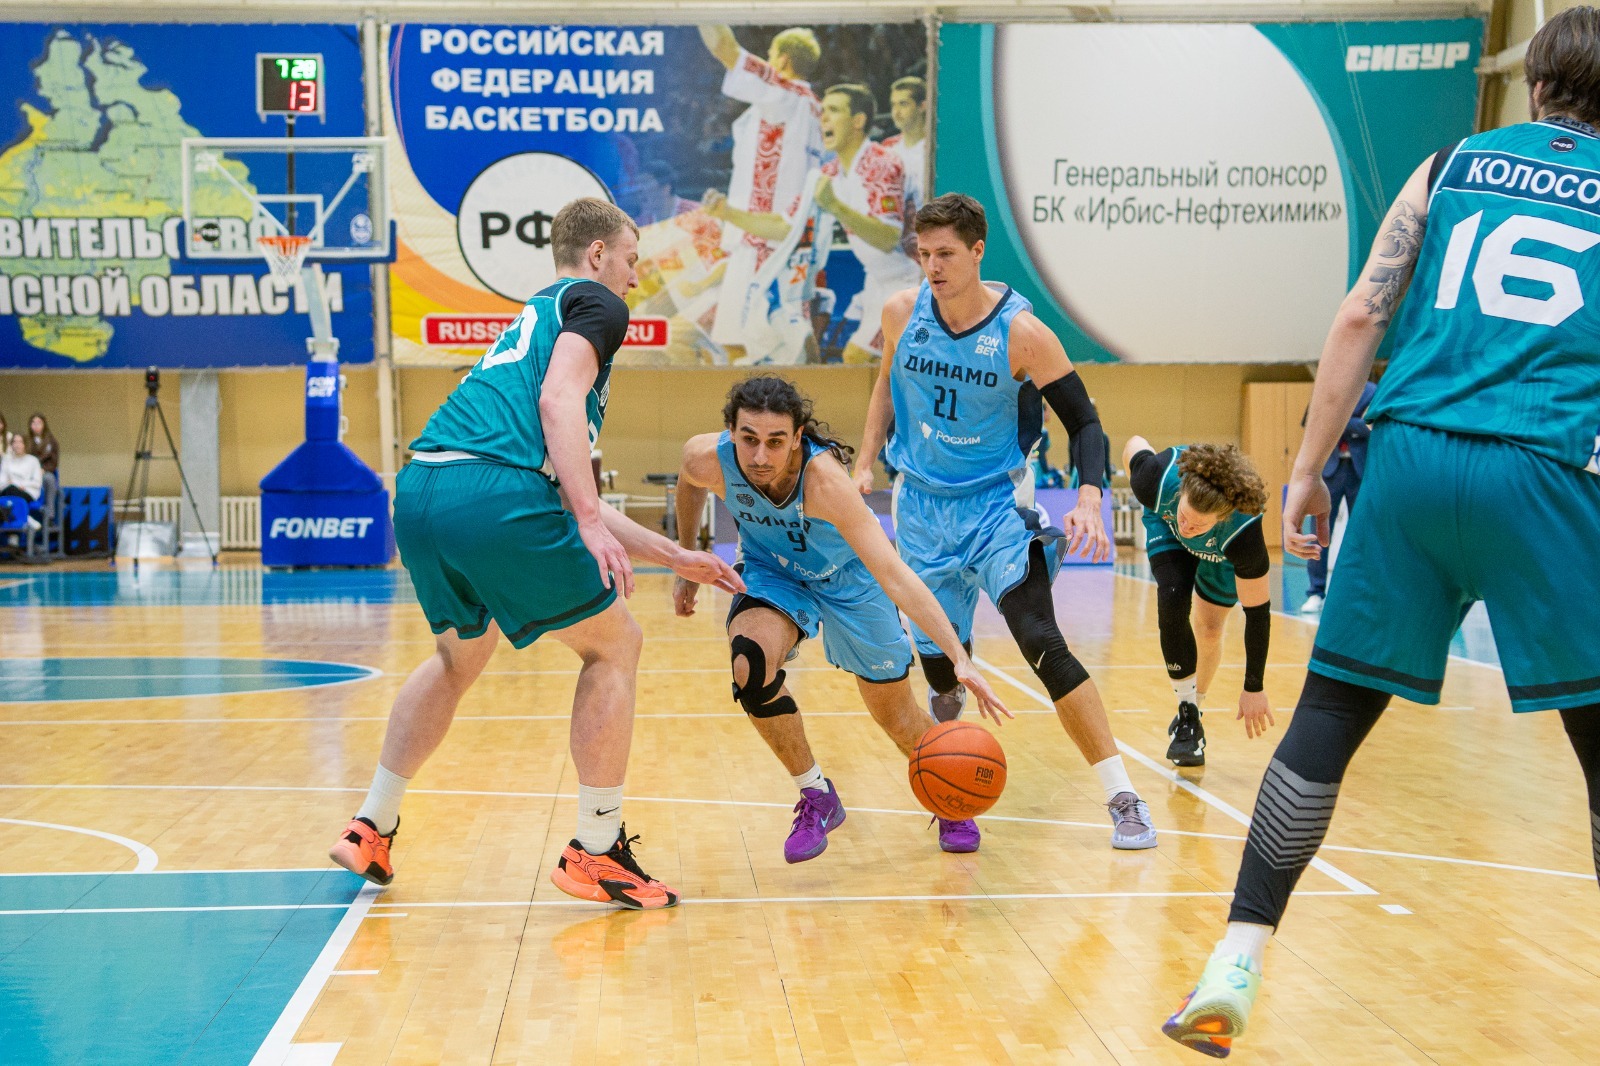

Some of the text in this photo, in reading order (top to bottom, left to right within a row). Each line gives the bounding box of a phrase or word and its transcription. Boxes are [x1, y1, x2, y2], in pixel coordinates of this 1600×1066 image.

[420, 26, 664, 56] РОССИЙСКАЯ
[1346, 42, 1470, 72] СИБУР
[290, 81, 316, 111] 13
[431, 67, 655, 98] ФЕДЕРАЦИЯ
[425, 105, 664, 133] БАСКЕТБОЛА
[1053, 158, 1327, 193] Генеральный спонсор
[1466, 157, 1600, 205] КОЛОСО
[1033, 196, 1342, 230] БК «Ирбис-Нефтехимик»
[480, 211, 553, 249] РФ
[1434, 209, 1600, 327] 16
[974, 344, 998, 357] BET
[976, 334, 1000, 348] FON
[903, 354, 998, 388] ДИНАМО
[933, 385, 958, 421] 21
[269, 517, 374, 539] FONBET
